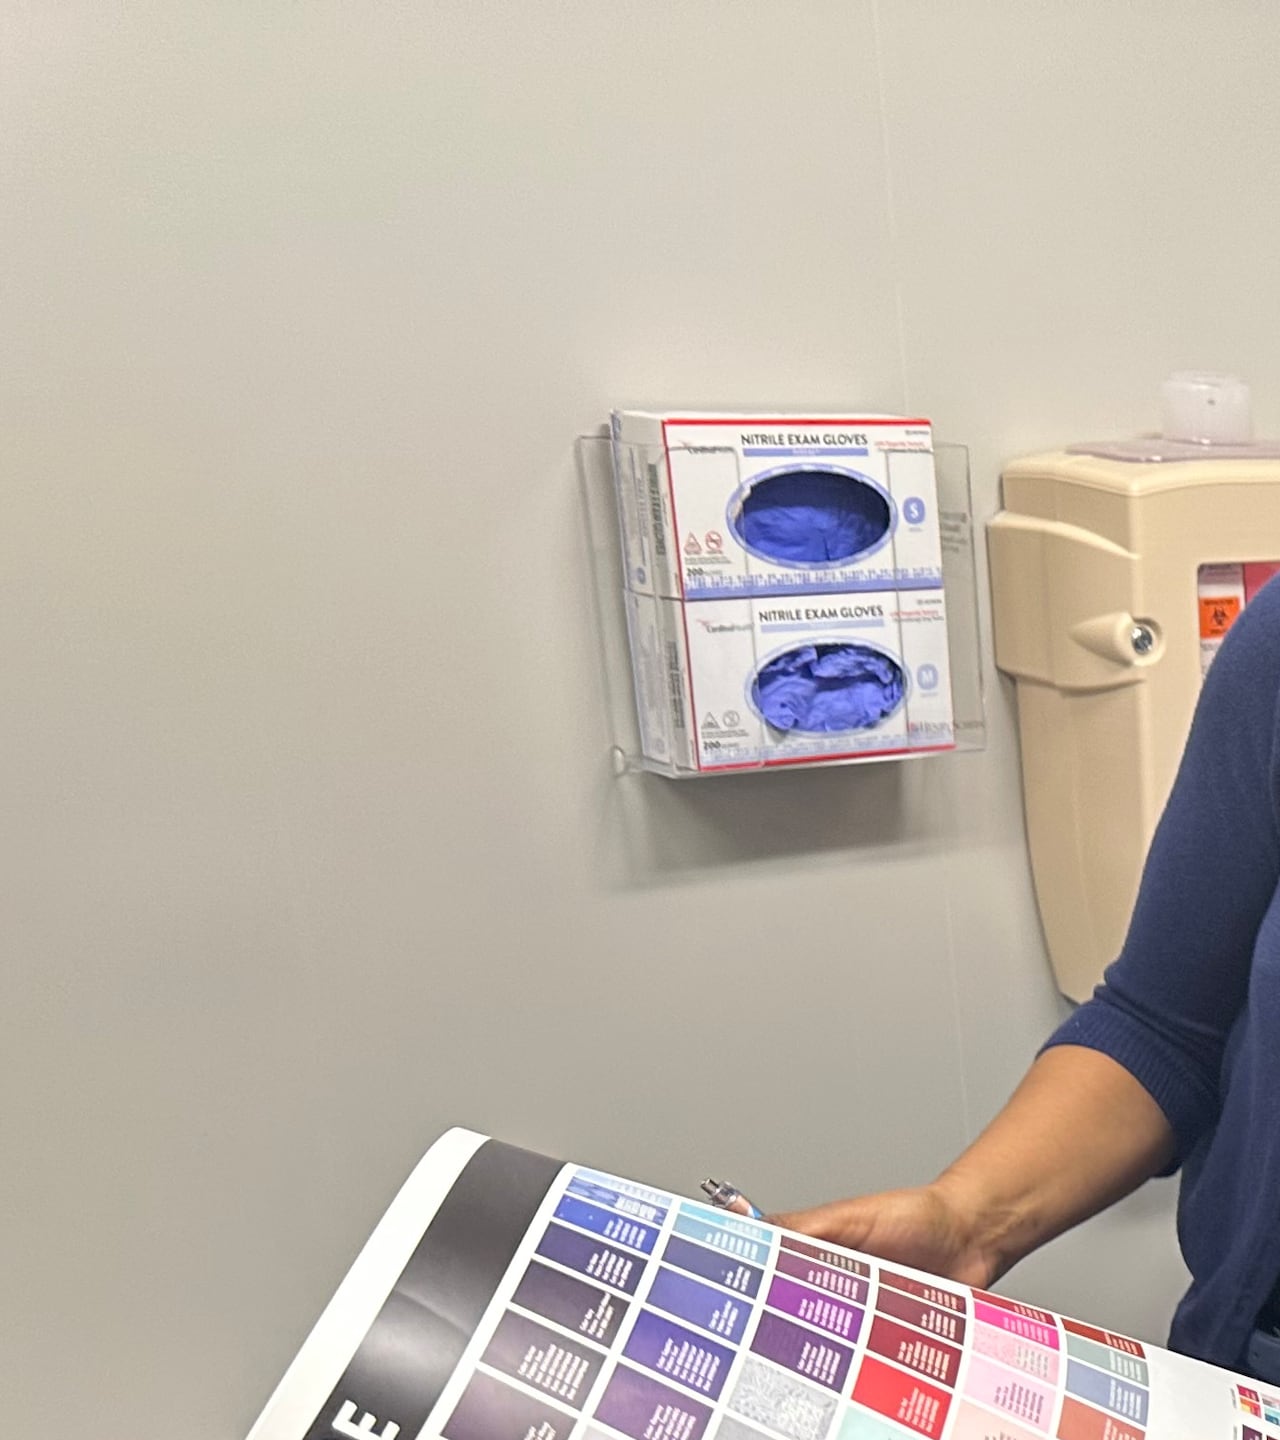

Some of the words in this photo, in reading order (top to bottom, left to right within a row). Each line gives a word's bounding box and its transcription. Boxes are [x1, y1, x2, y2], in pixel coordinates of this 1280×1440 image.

[741, 434, 785, 447] NITRILE
[788, 433, 820, 446] EXAM
[822, 432, 868, 446] GLOVES
[758, 610, 802, 623] NITRILE
[805, 608, 838, 621] EXAM
[840, 605, 883, 619] GLOVES
